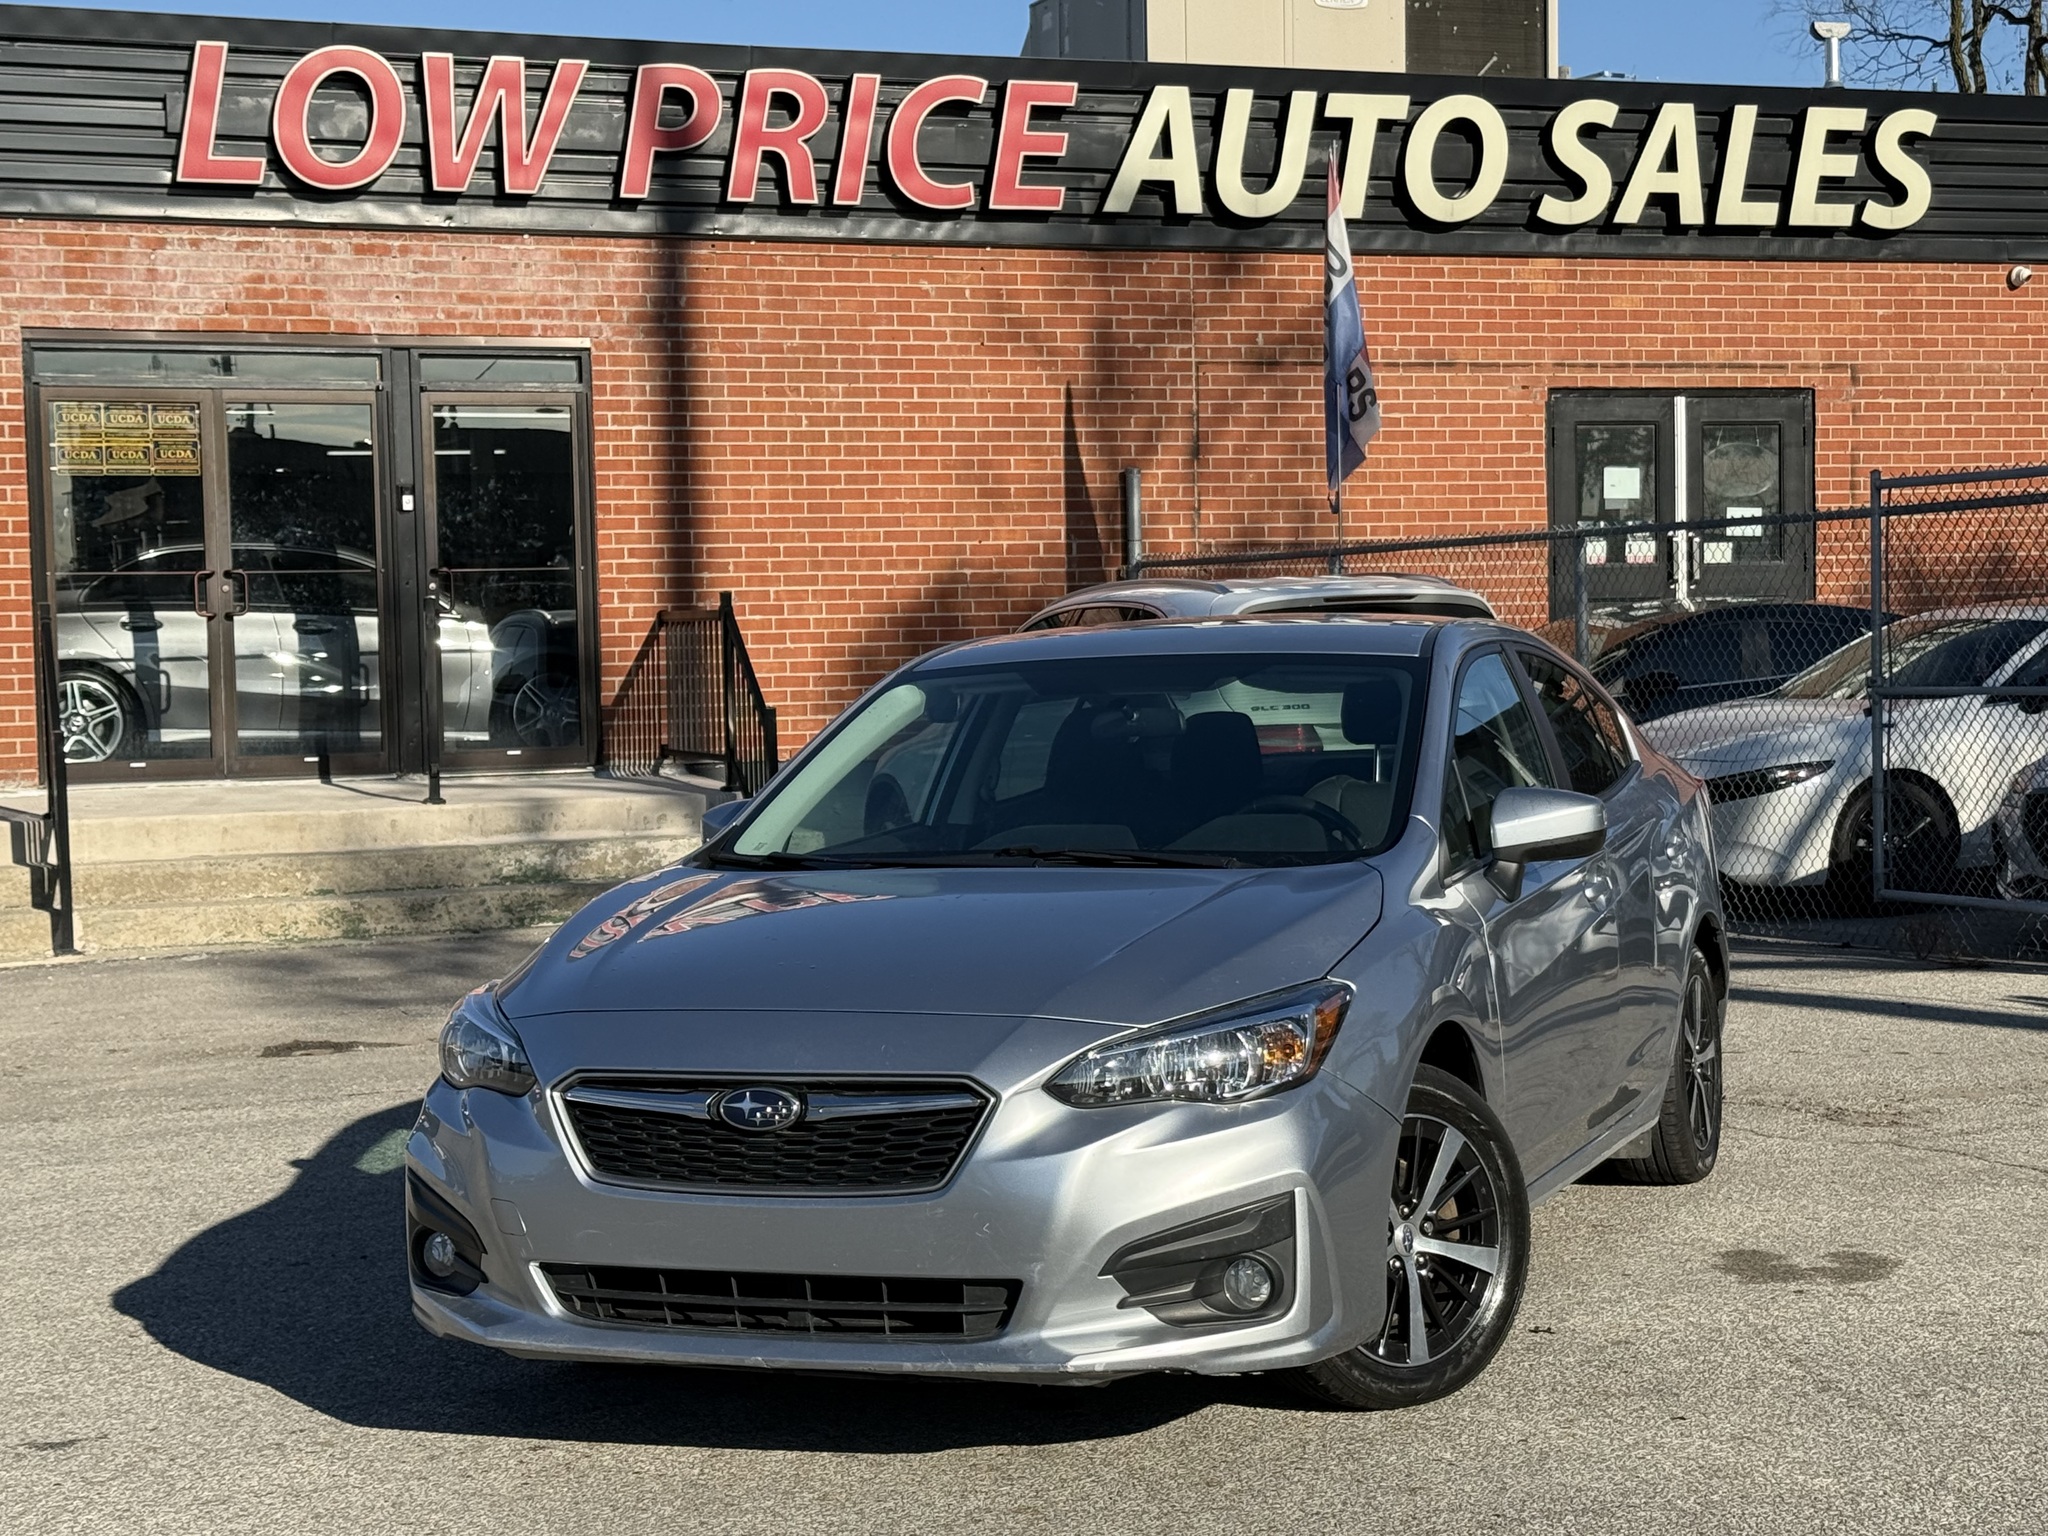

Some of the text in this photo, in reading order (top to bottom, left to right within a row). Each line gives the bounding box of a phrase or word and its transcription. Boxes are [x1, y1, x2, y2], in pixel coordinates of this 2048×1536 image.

[175, 40, 1938, 231] LOW PRICE AUTO SALES
[62, 413, 96, 422] UCDA
[110, 414, 144, 423] UCDA
[157, 415, 190, 424] UCDA
[64, 450, 96, 459] UCDA
[112, 450, 144, 459] UCDA
[160, 449, 193, 458] UCDA
